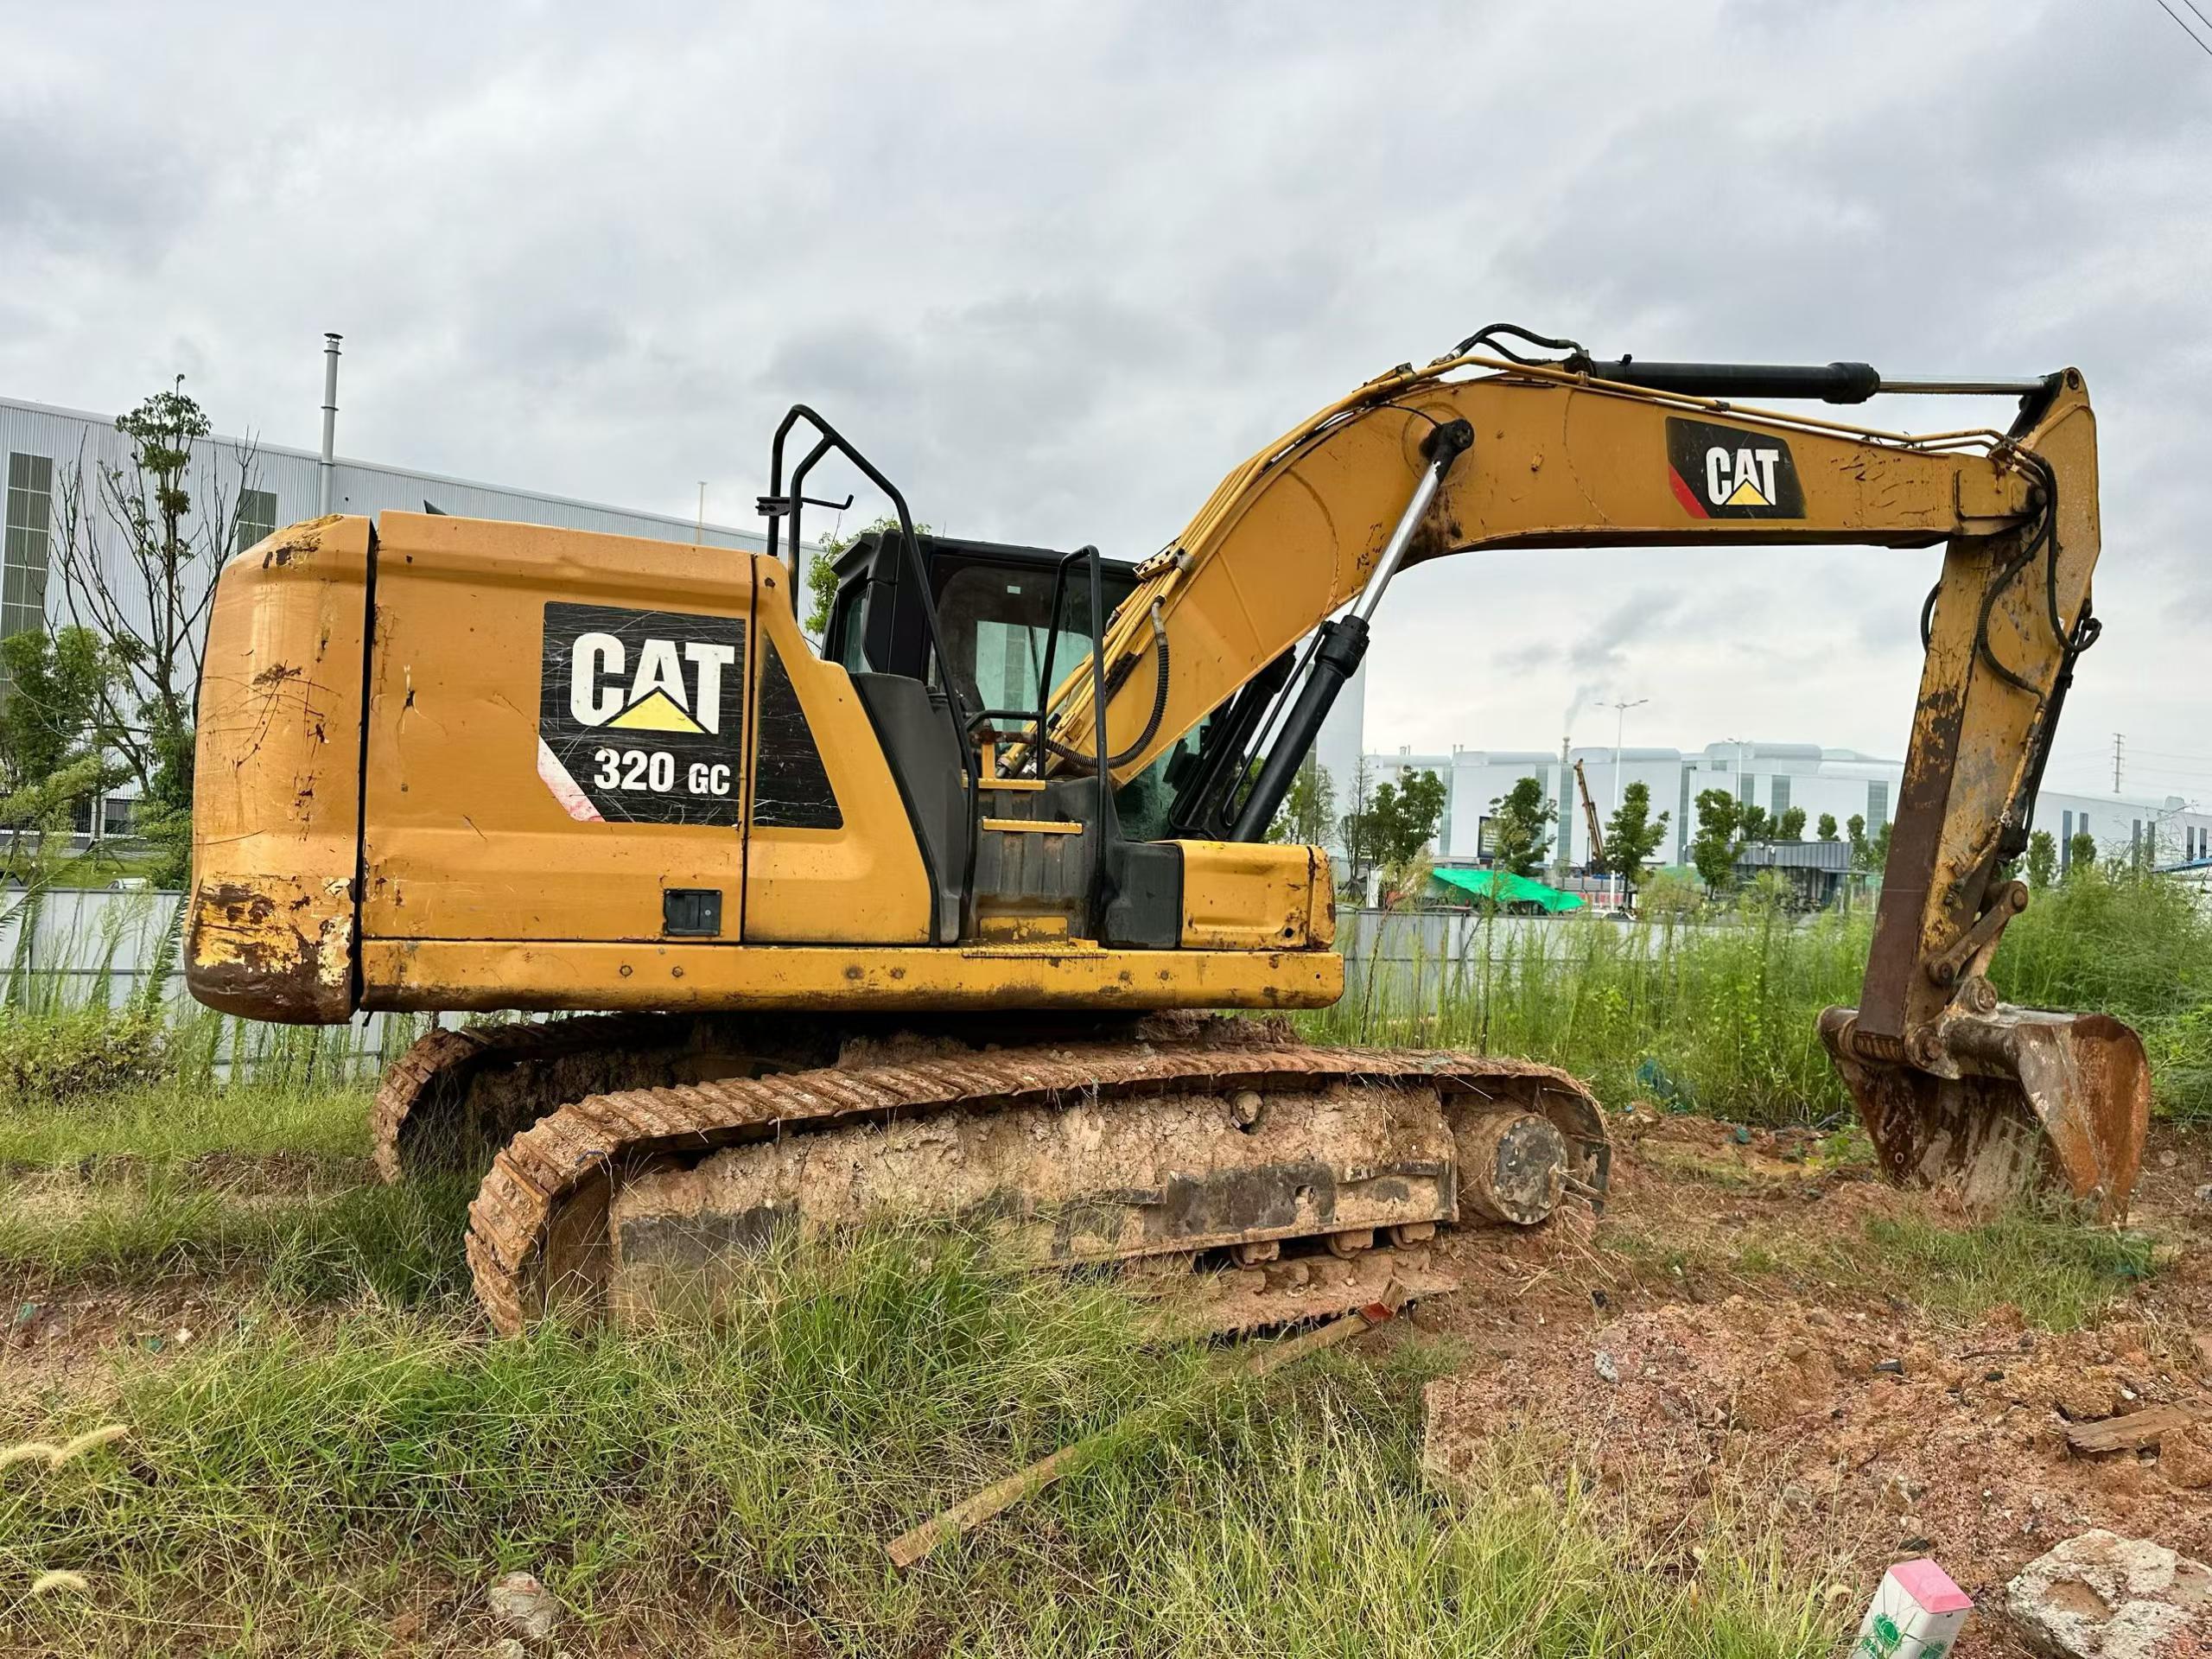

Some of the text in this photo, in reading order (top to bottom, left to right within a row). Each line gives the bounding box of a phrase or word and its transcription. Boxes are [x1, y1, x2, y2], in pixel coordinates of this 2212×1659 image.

[1706, 447, 1779, 505] CAT
[570, 632, 735, 734] CAT
[594, 748, 731, 795] 320 GC
